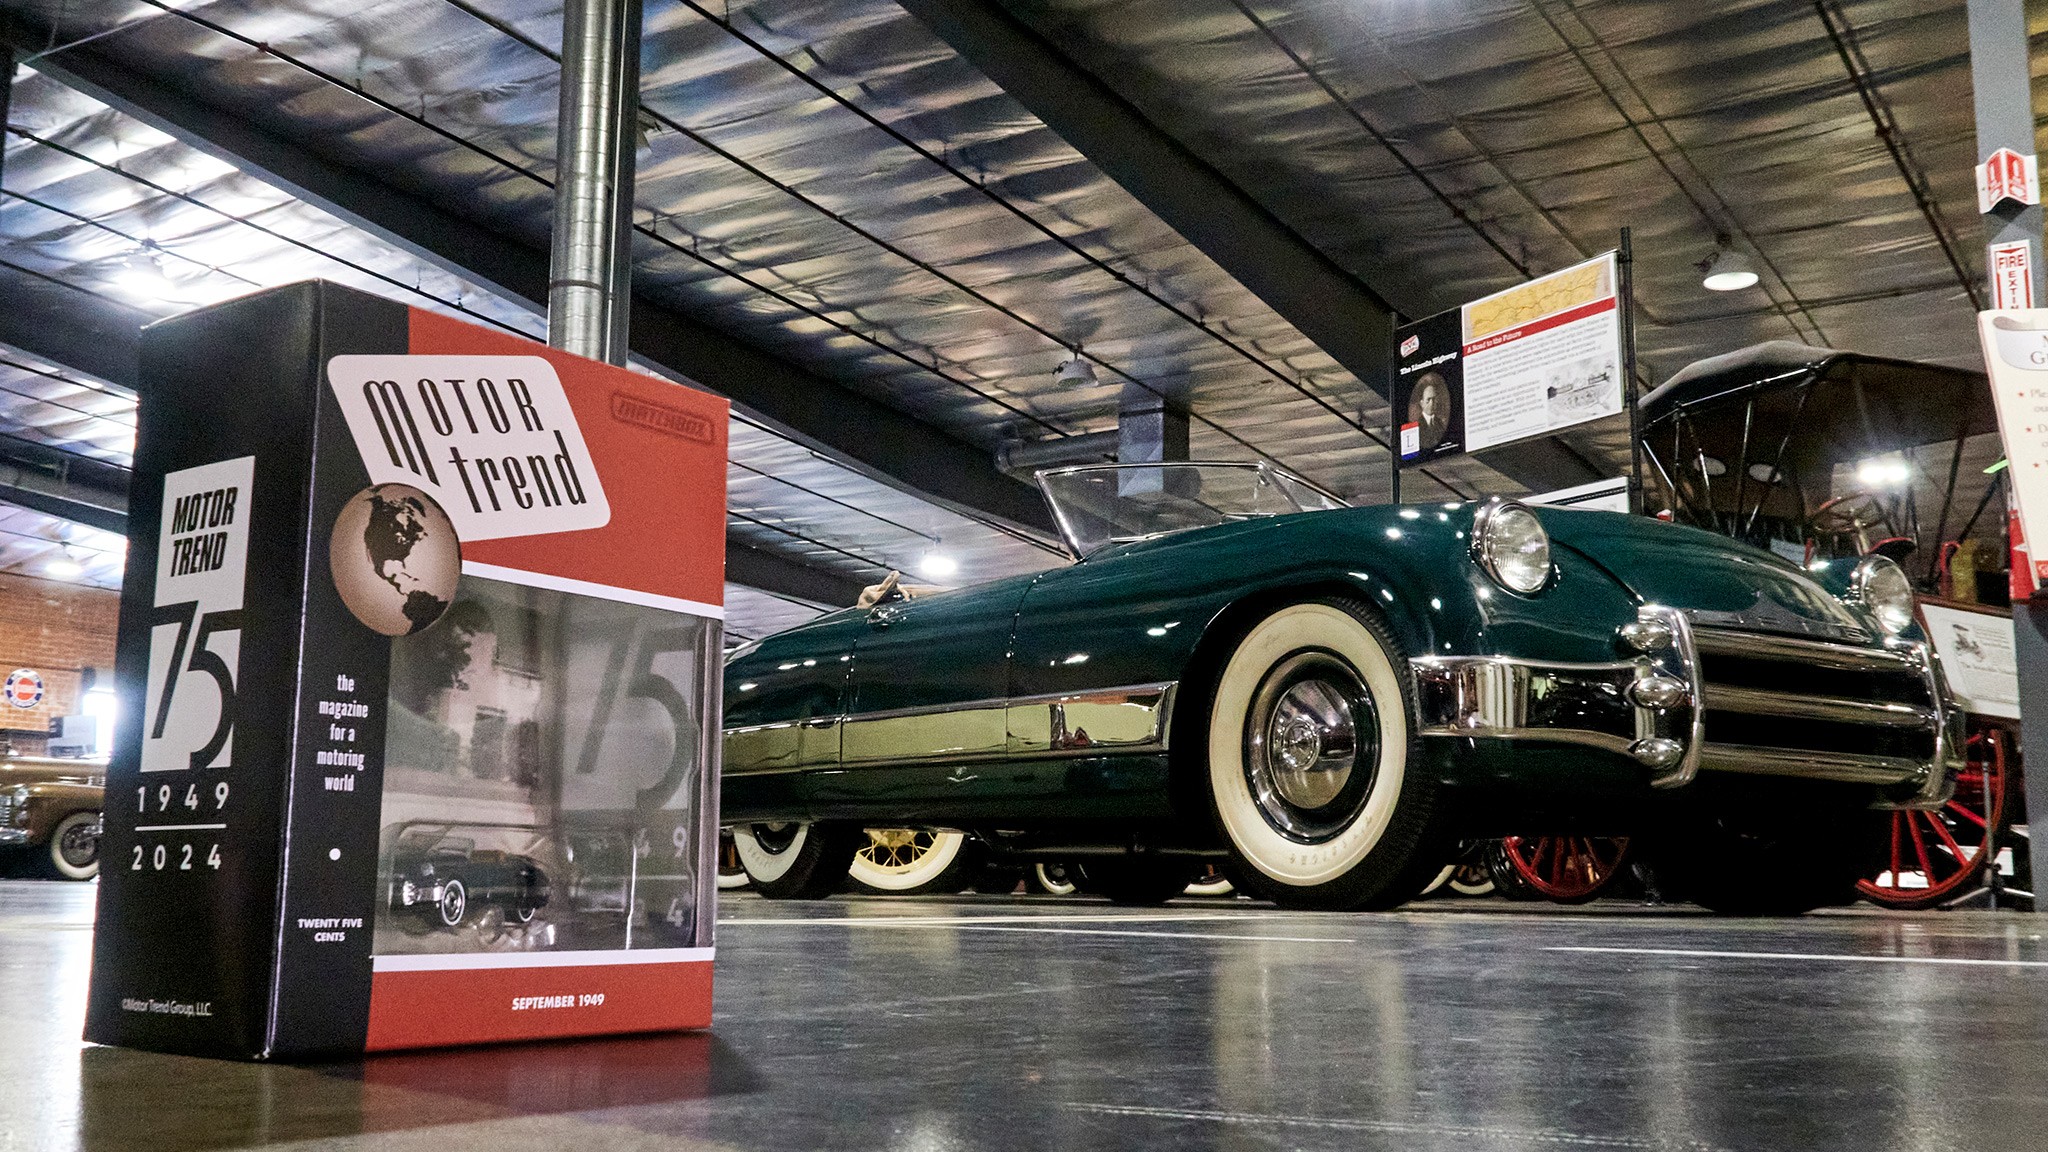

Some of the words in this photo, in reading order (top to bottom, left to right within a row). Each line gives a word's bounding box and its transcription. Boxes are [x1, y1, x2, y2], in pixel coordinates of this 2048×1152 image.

[1999, 254, 2024, 269] FIRE
[2030, 350, 2048, 365] G
[1399, 366, 1411, 375] The
[617, 399, 707, 438] MATCHBOX
[363, 378, 544, 487] MOTOR
[1406, 435, 1414, 448] L
[448, 429, 587, 513] trend
[171, 487, 238, 535] MOTOR
[170, 532, 228, 577] TREND
[149, 600, 243, 769] 75
[337, 674, 355, 692] the
[319, 700, 369, 719] magazine
[330, 723, 346, 741] for
[348, 728, 355, 742] a
[317, 749, 364, 771] motoring
[324, 774, 355, 792] world
[138, 782, 229, 813] 1949
[132, 844, 222, 870] 2024
[297, 918, 340, 929] TWENTY
[342, 918, 363, 928] FIVE
[314, 931, 345, 942] CENTS
[148, 999, 169, 1013] Trend
[512, 995, 575, 1010] SEPTEMBER
[578, 993, 605, 1007] 1949
